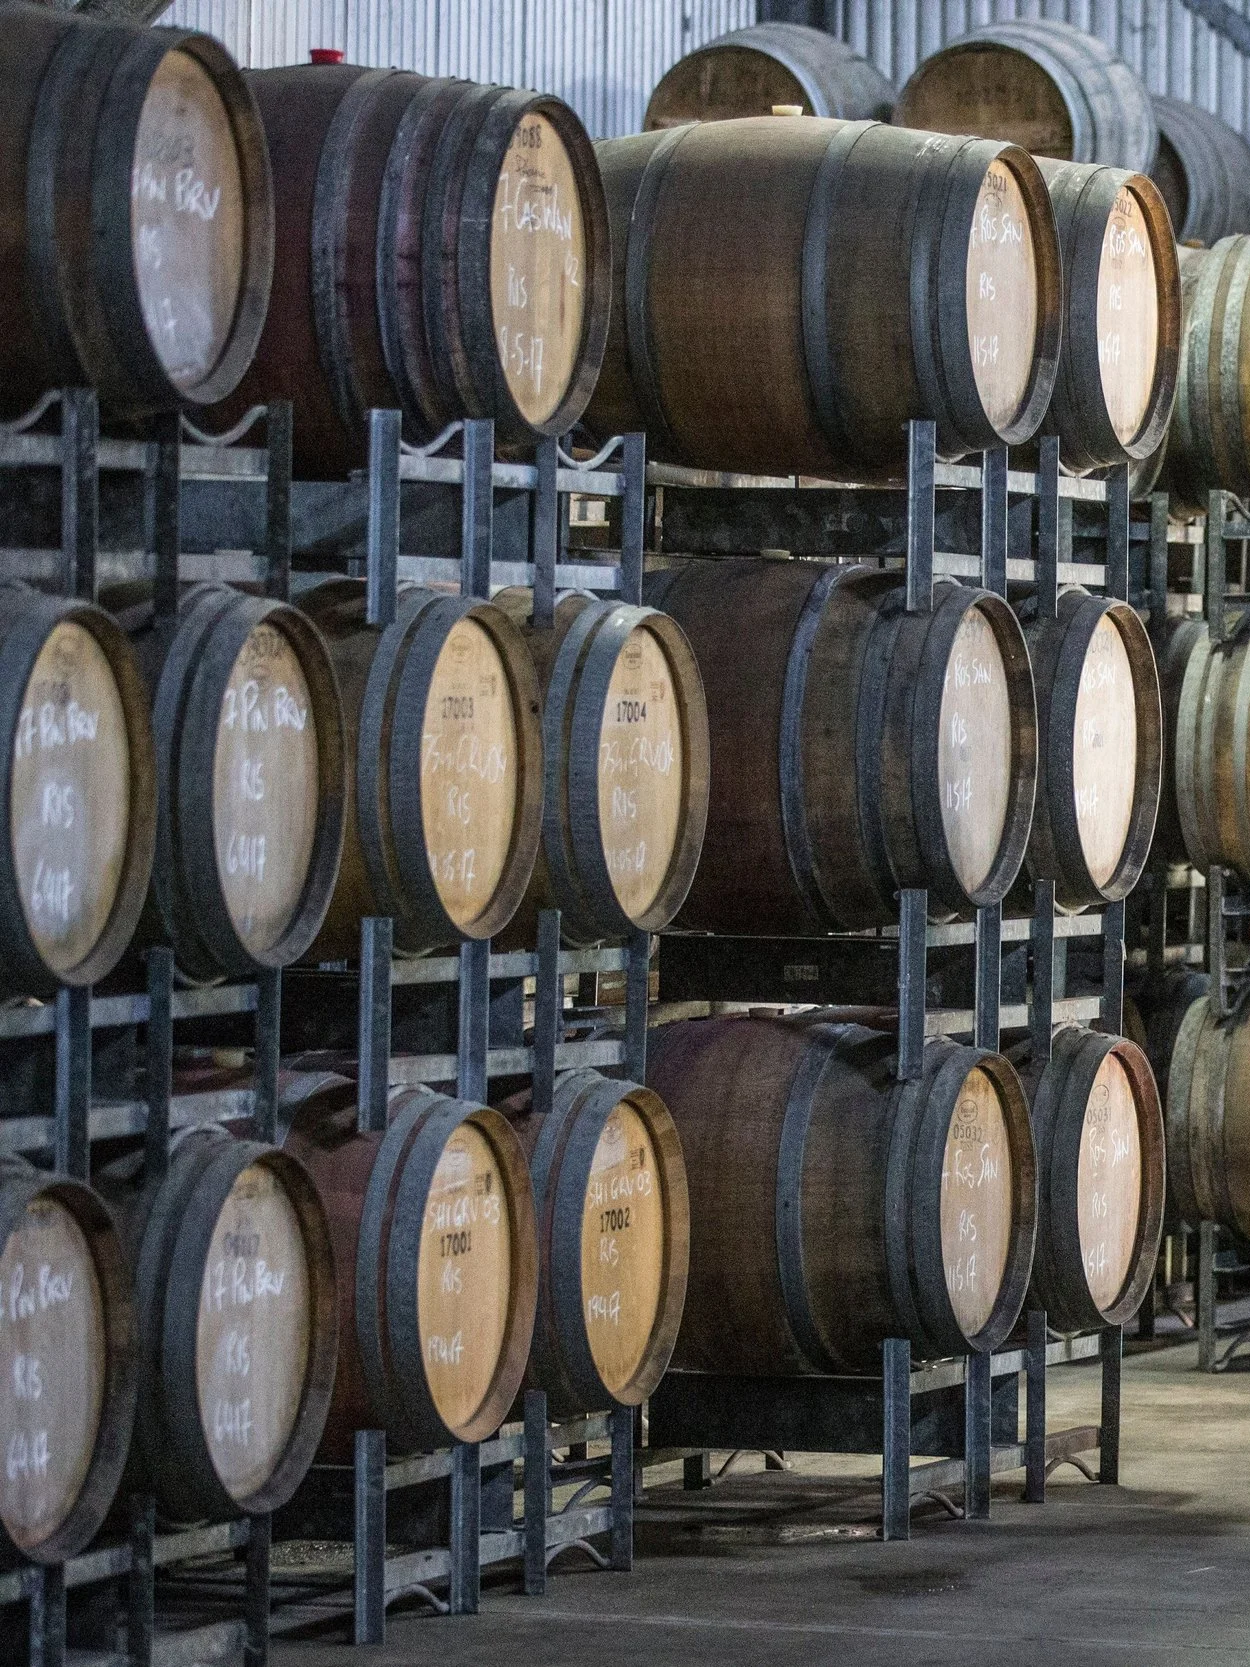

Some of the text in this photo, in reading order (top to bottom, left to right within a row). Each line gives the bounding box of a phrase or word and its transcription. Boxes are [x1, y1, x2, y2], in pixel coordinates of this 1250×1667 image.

[616, 701, 647, 723] 17004
[953, 1124, 983, 1144] 05032
[600, 1207, 630, 1233] 17002
[440, 1231, 471, 1257] 17001
